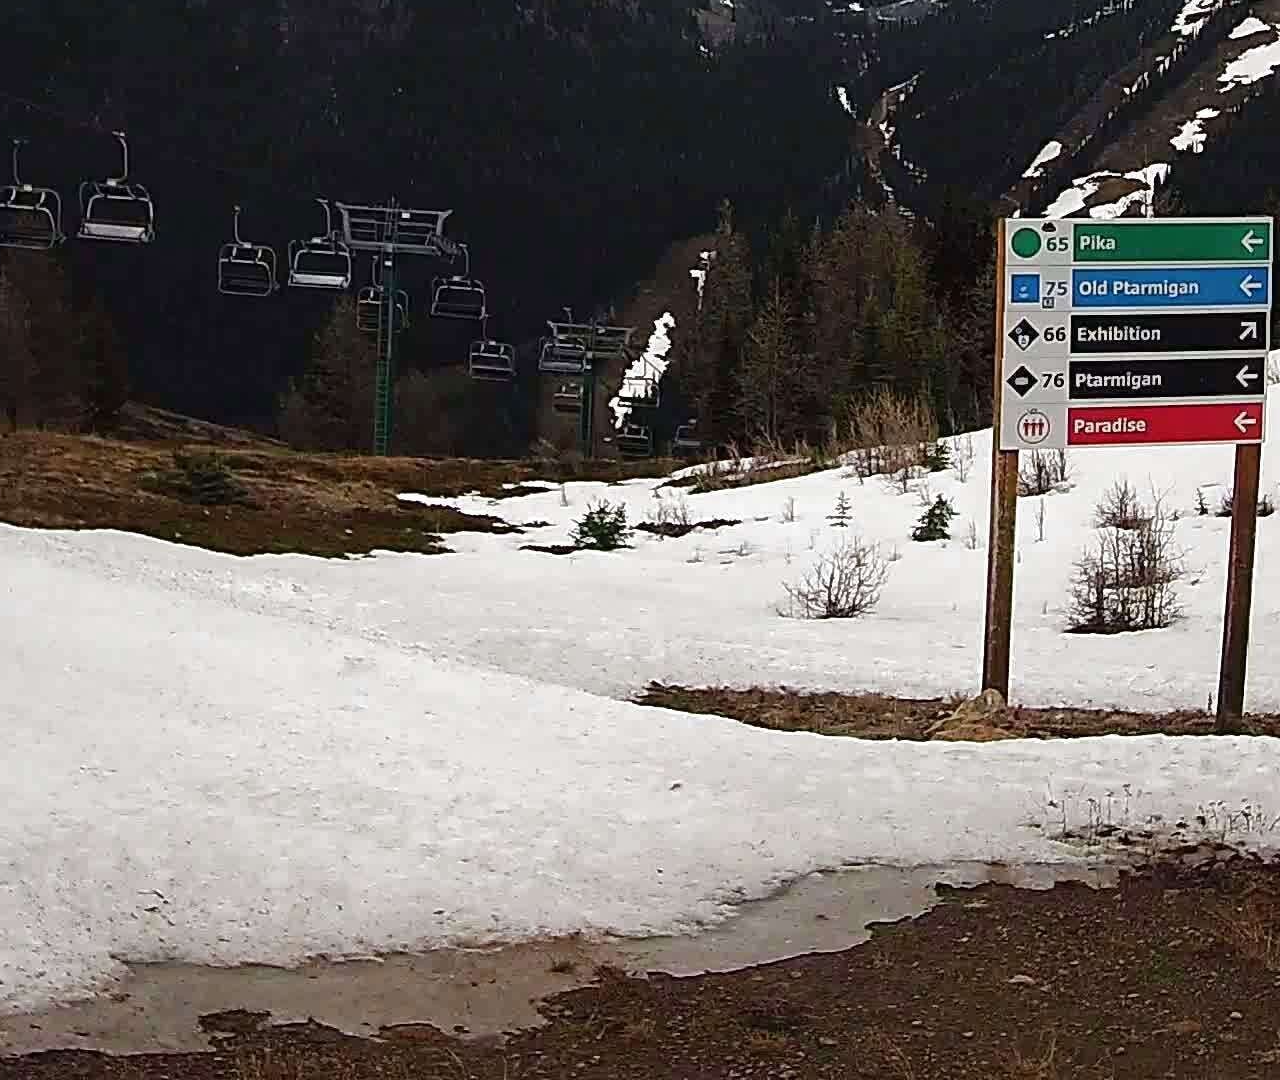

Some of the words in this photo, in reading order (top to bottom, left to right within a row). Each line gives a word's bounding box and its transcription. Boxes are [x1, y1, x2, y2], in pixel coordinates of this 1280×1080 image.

[1046, 236, 1069, 252] 65
[1079, 235, 1117, 251] Pika
[1045, 280, 1068, 296] 75
[1078, 280, 1108, 296] Old
[1112, 280, 1200, 298] Ptarmigan
[1043, 327, 1067, 342] 66
[1076, 325, 1162, 342] Exhibition
[1041, 372, 1065, 389] 76
[1075, 371, 1163, 390] Ptarmigan
[1073, 417, 1147, 434] Paradise
